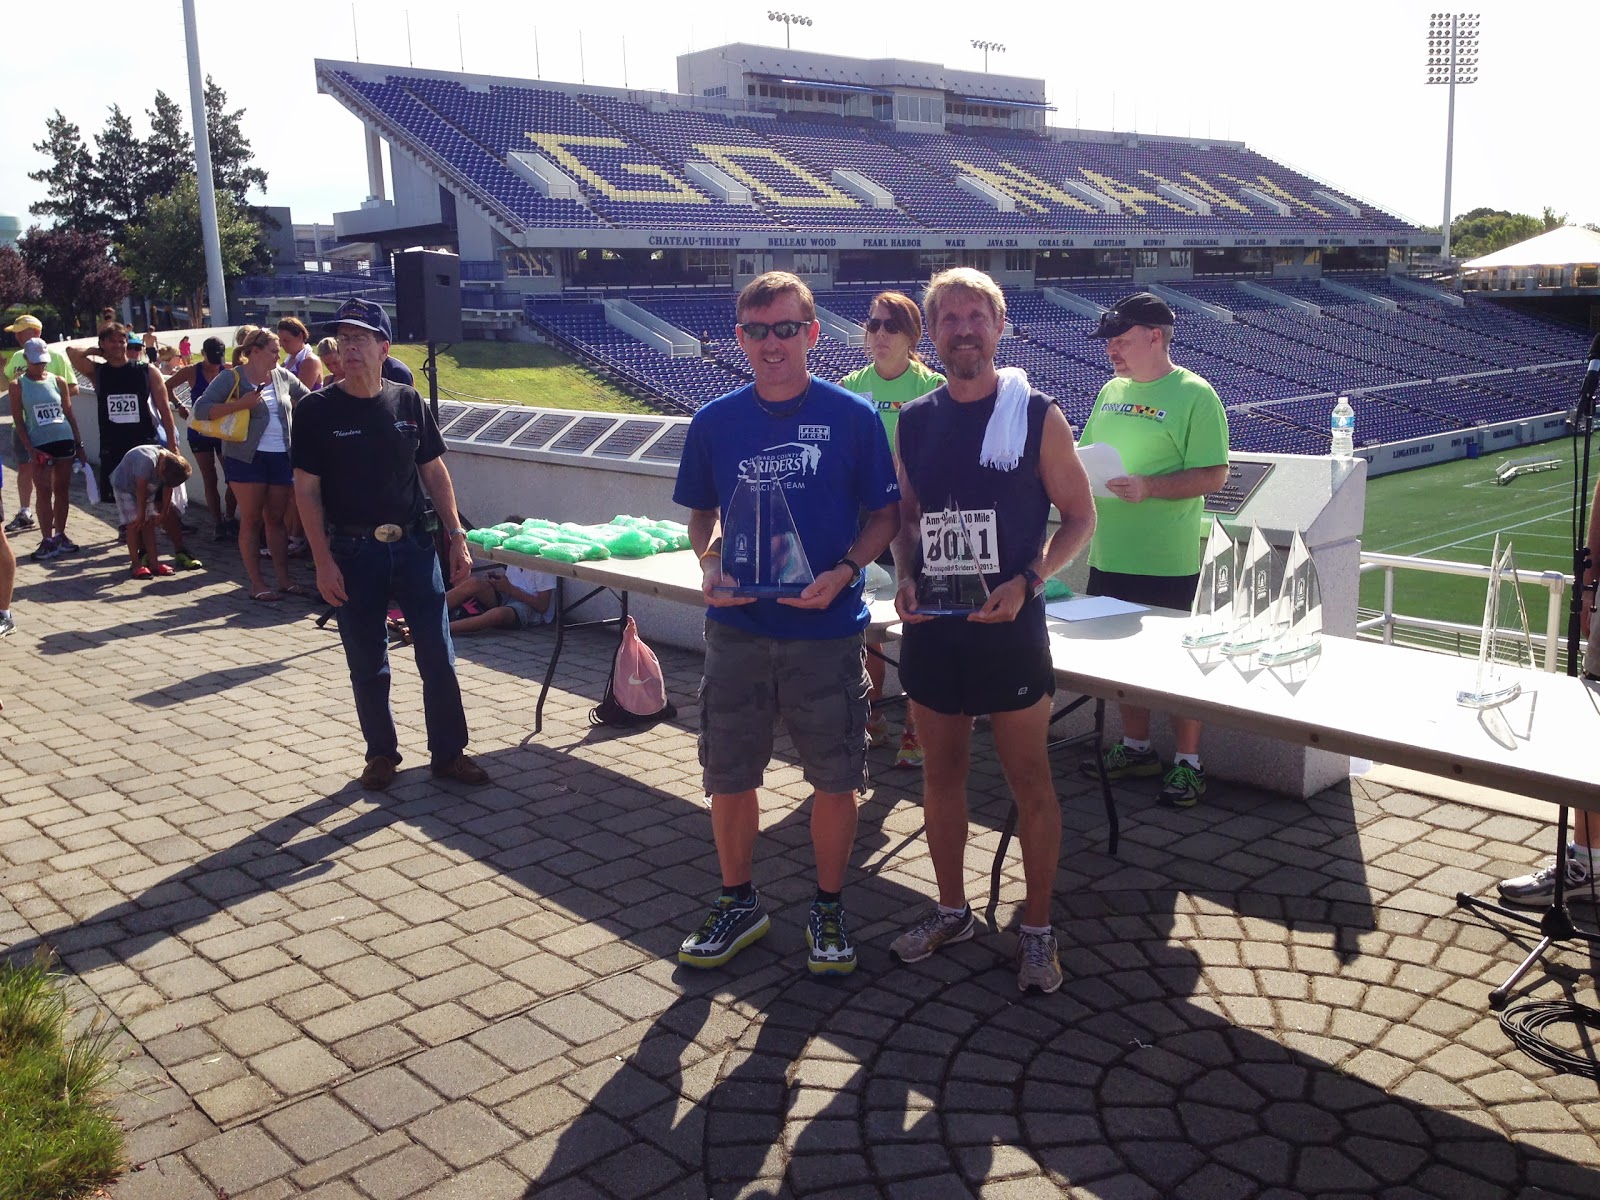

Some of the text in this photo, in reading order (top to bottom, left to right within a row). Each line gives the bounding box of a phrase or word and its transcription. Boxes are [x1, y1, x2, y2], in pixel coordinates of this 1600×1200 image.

[525, 132, 863, 208] GO
[648, 236, 741, 247] CHATEAU-THIERRY
[768, 237, 837, 247] BELLEAU WOOD
[863, 238, 921, 247] PEARL HARBOR
[945, 239, 966, 247] WAKE
[986, 239, 1018, 247] JAVA SEA
[1038, 239, 1074, 247] CORAL SEA
[110, 400, 136, 412] 2929
[38, 408, 62, 420] 4012
[750, 455, 776, 463] HARD
[964, 514, 972, 524] 10
[974, 512, 990, 522] Mile
